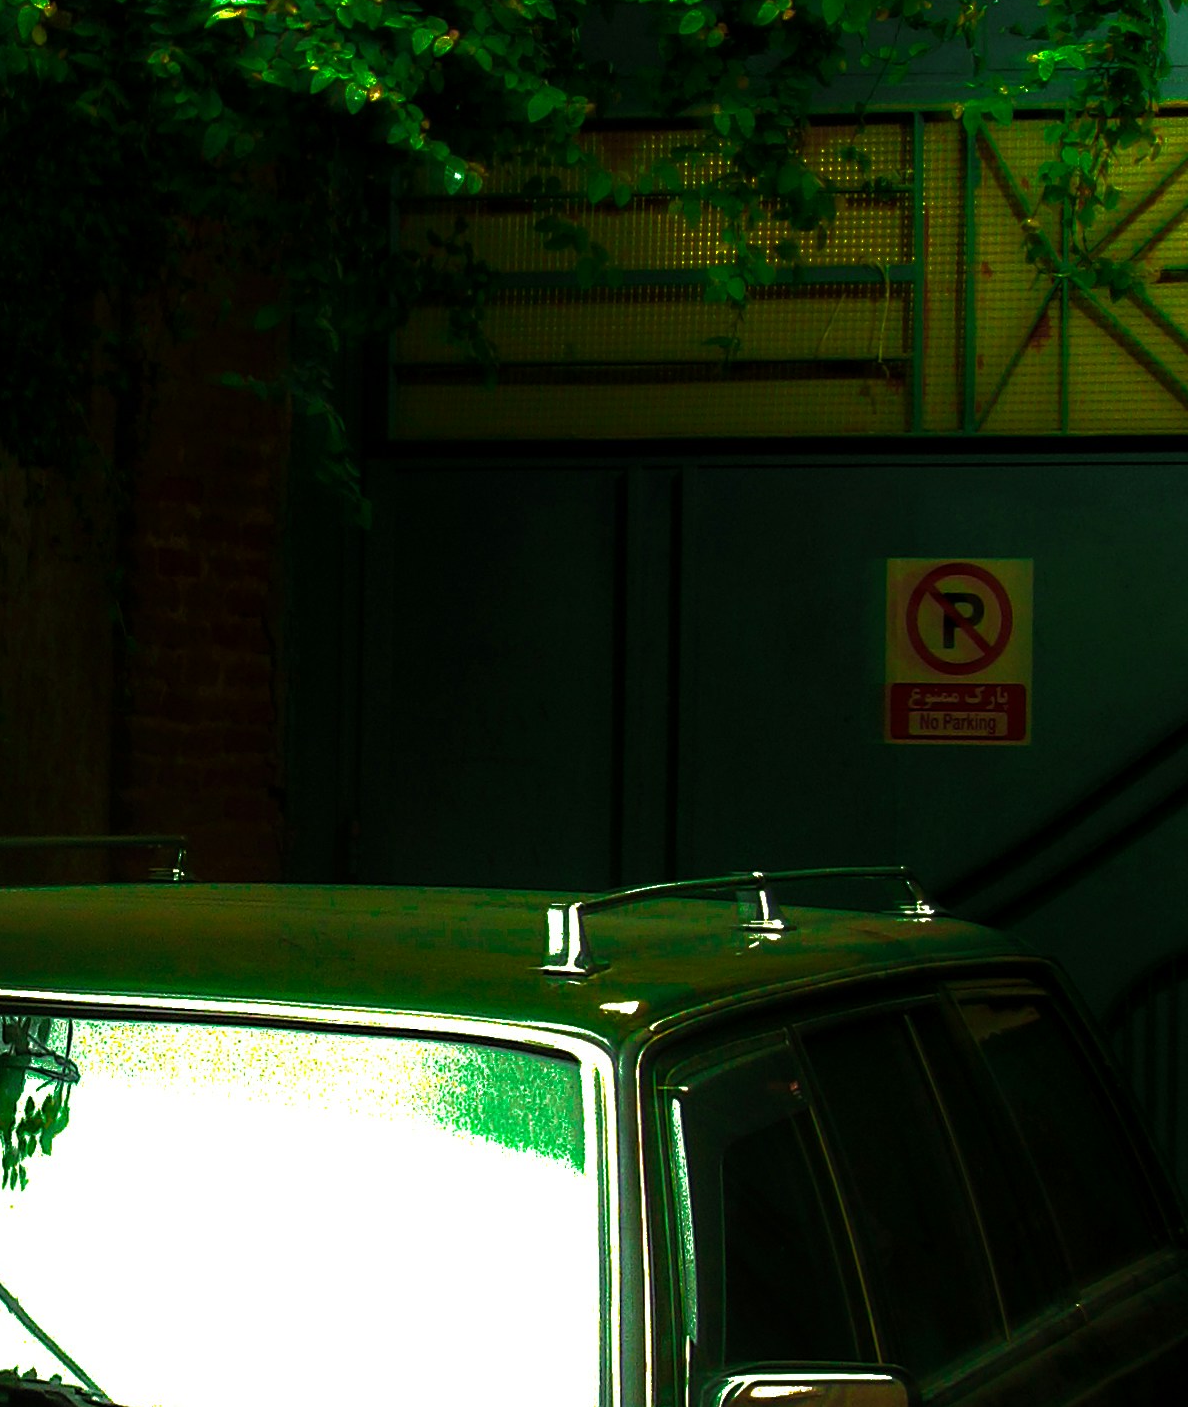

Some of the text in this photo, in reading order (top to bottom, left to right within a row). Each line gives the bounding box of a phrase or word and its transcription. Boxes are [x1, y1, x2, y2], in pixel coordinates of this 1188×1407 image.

[908, 687, 1009, 711] پارک ممنوع
[920, 714, 996, 734] No Parking
